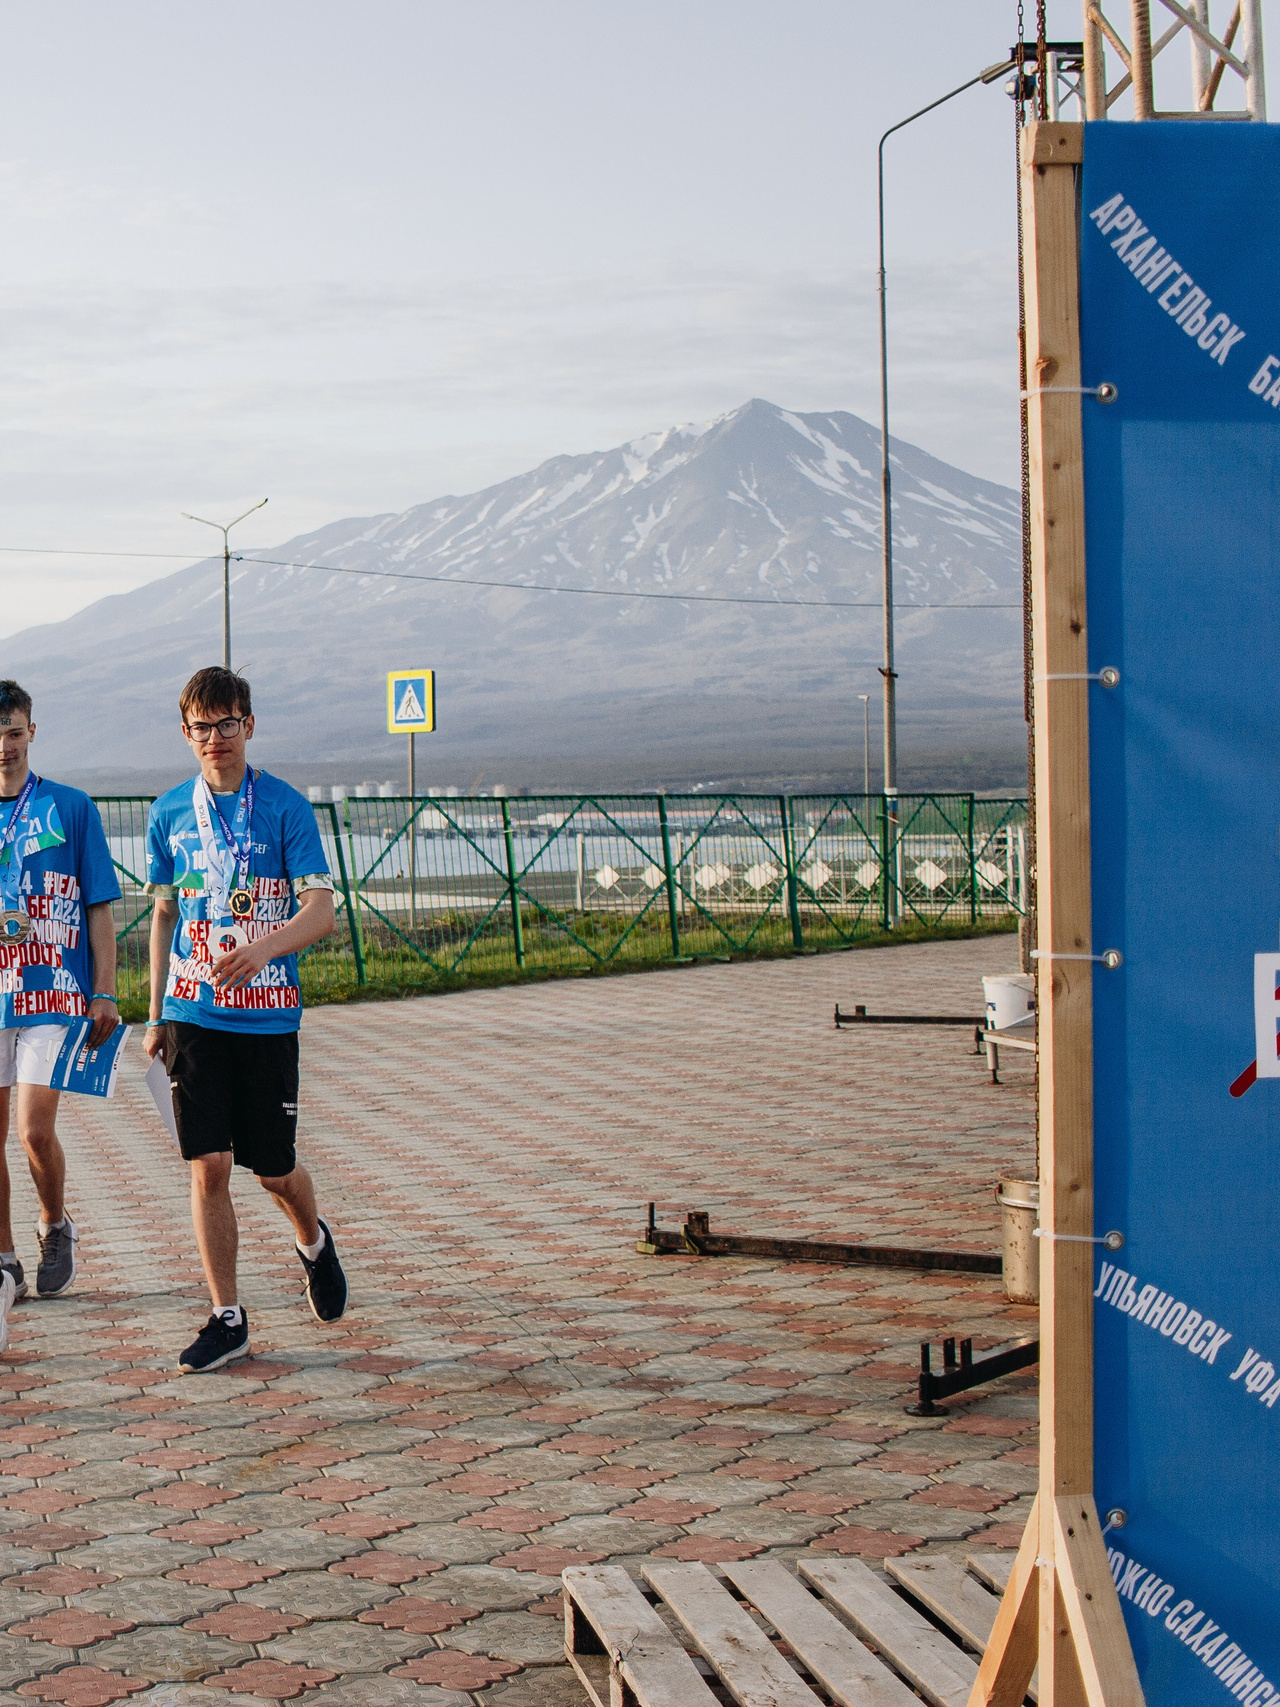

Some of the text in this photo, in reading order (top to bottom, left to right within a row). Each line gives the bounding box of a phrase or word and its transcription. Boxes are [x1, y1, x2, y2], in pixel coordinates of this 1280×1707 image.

[1089, 192, 1246, 366] АРХАНГЕЛЬСК
[213, 985, 300, 1009] #ЕДИНСТВО
[1093, 1261, 1233, 1365] УЛЬЯНОВСК
